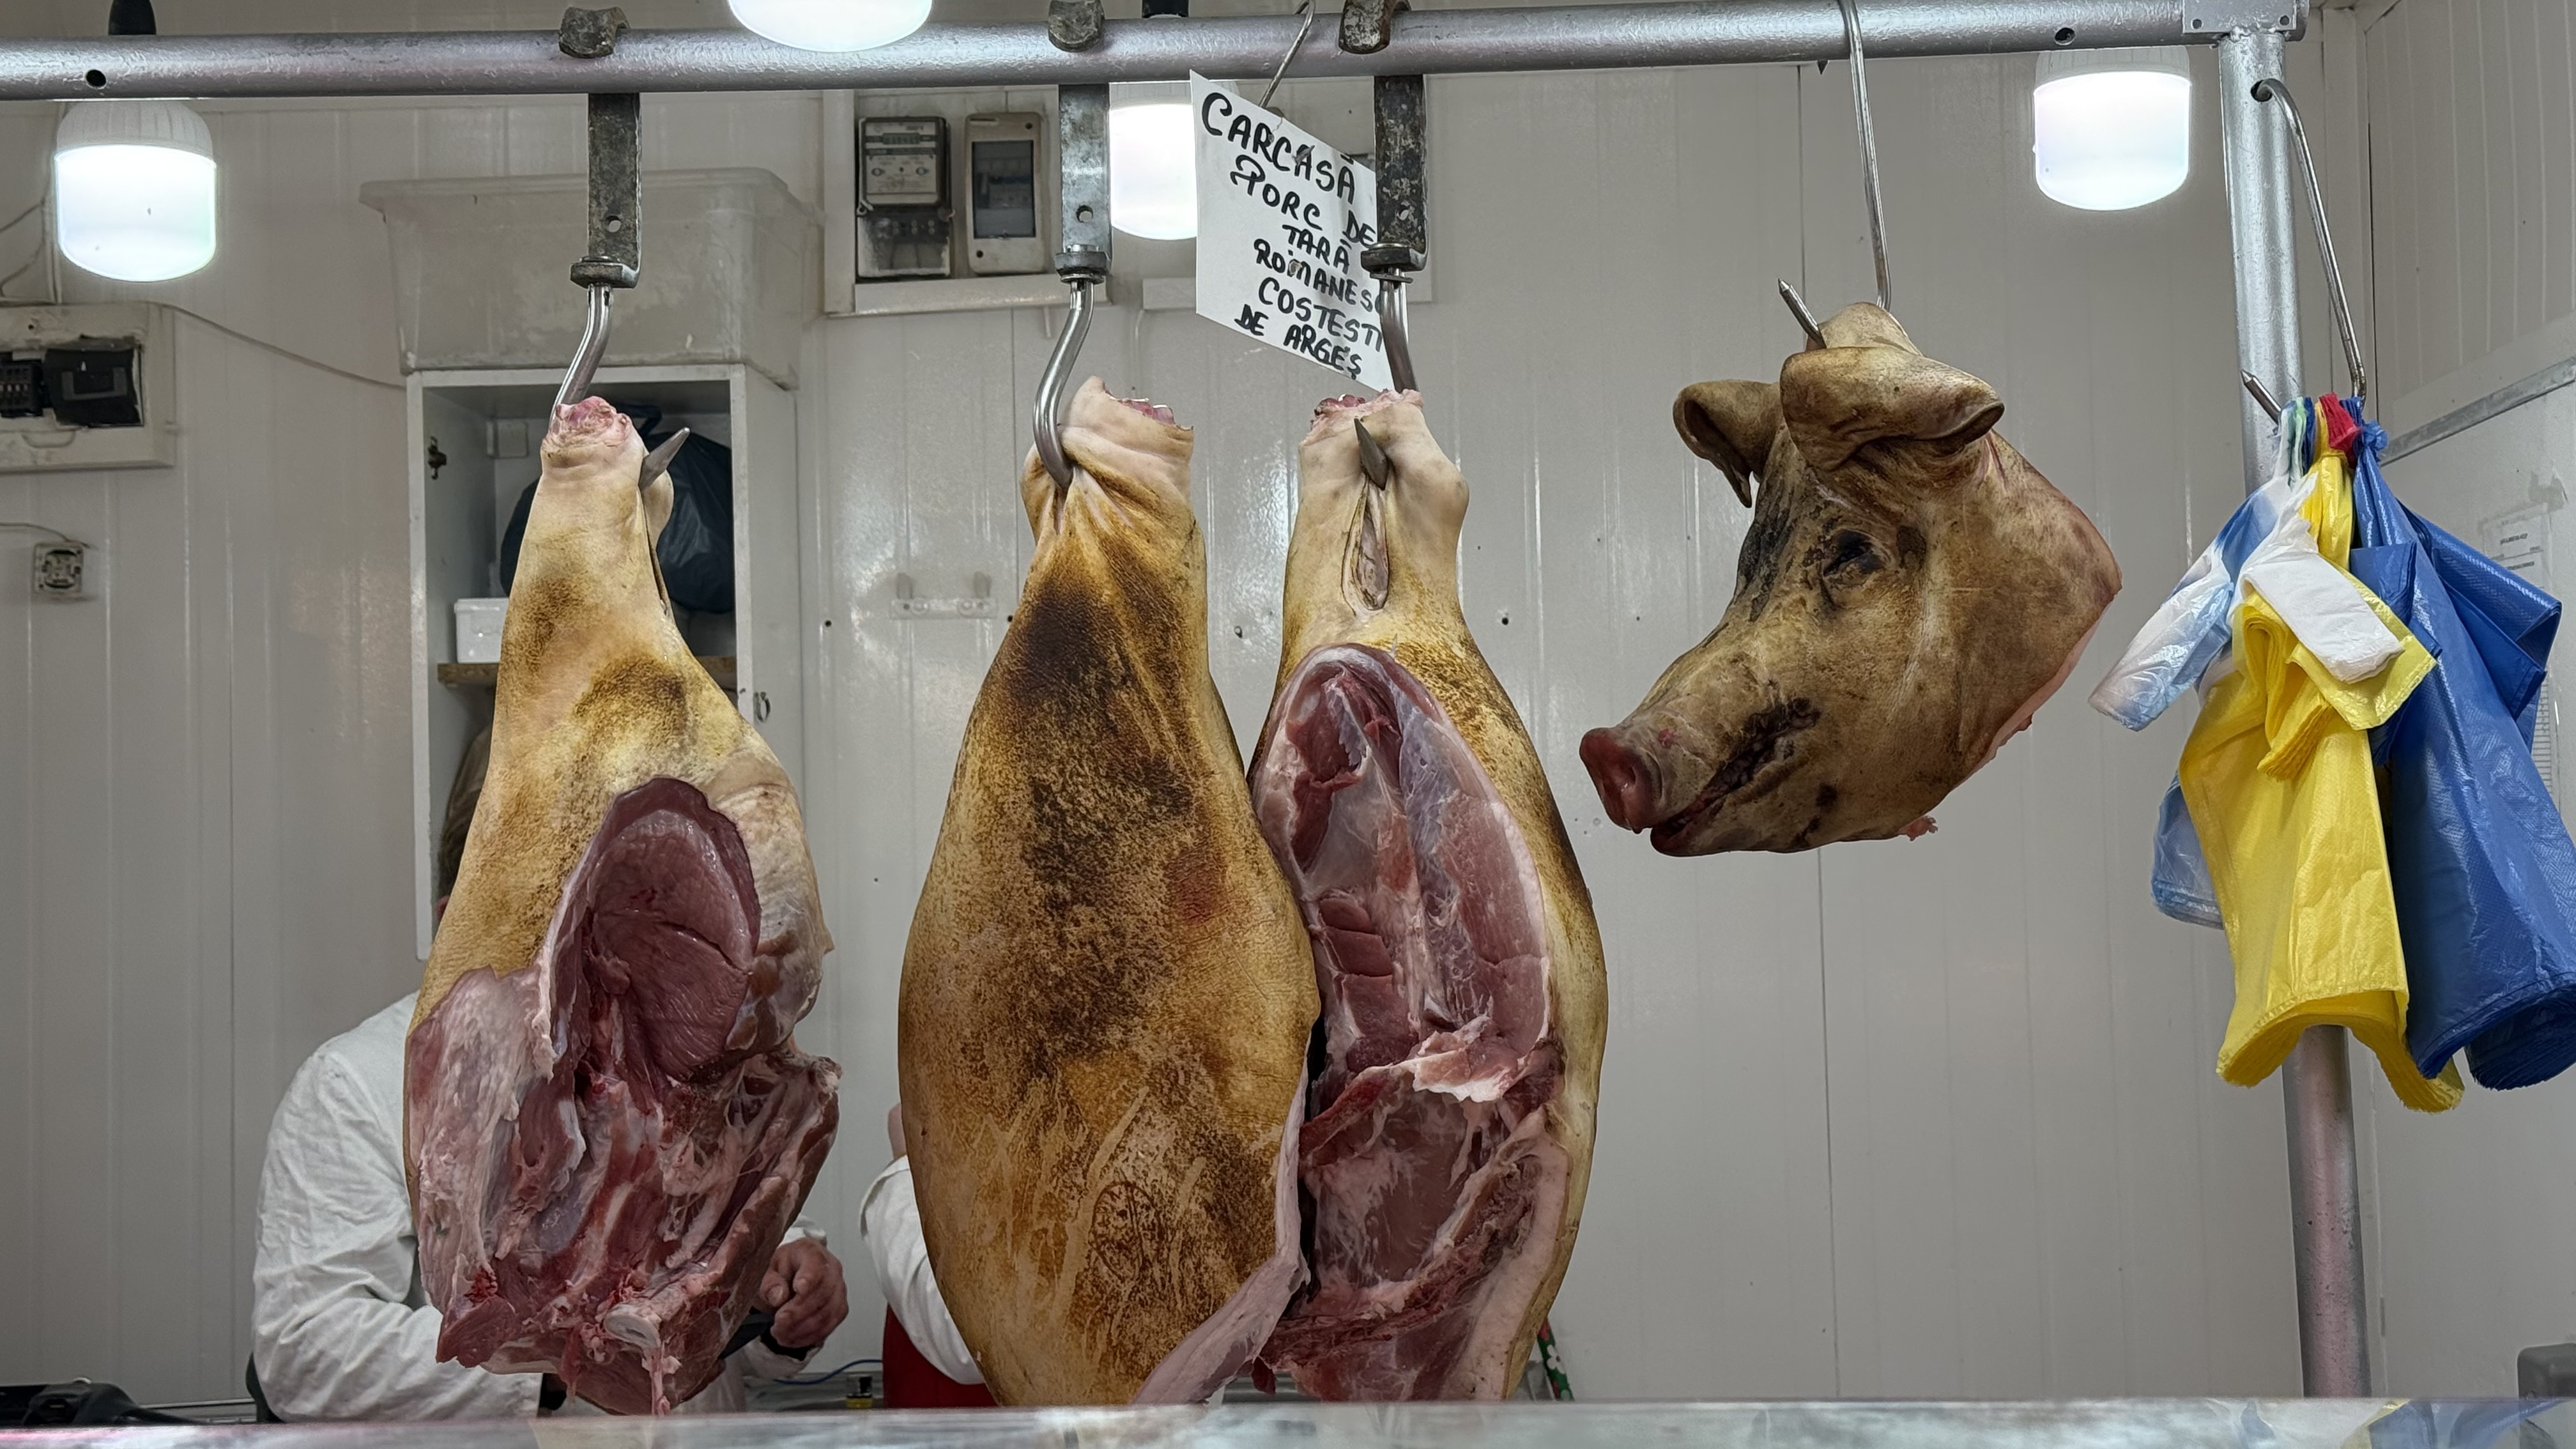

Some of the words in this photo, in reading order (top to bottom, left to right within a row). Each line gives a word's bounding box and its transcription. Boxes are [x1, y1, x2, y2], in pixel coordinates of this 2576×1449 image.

[1230, 154, 1322, 231] PORC
[1342, 210, 1376, 249] DE
[1234, 303, 1269, 336] DE
